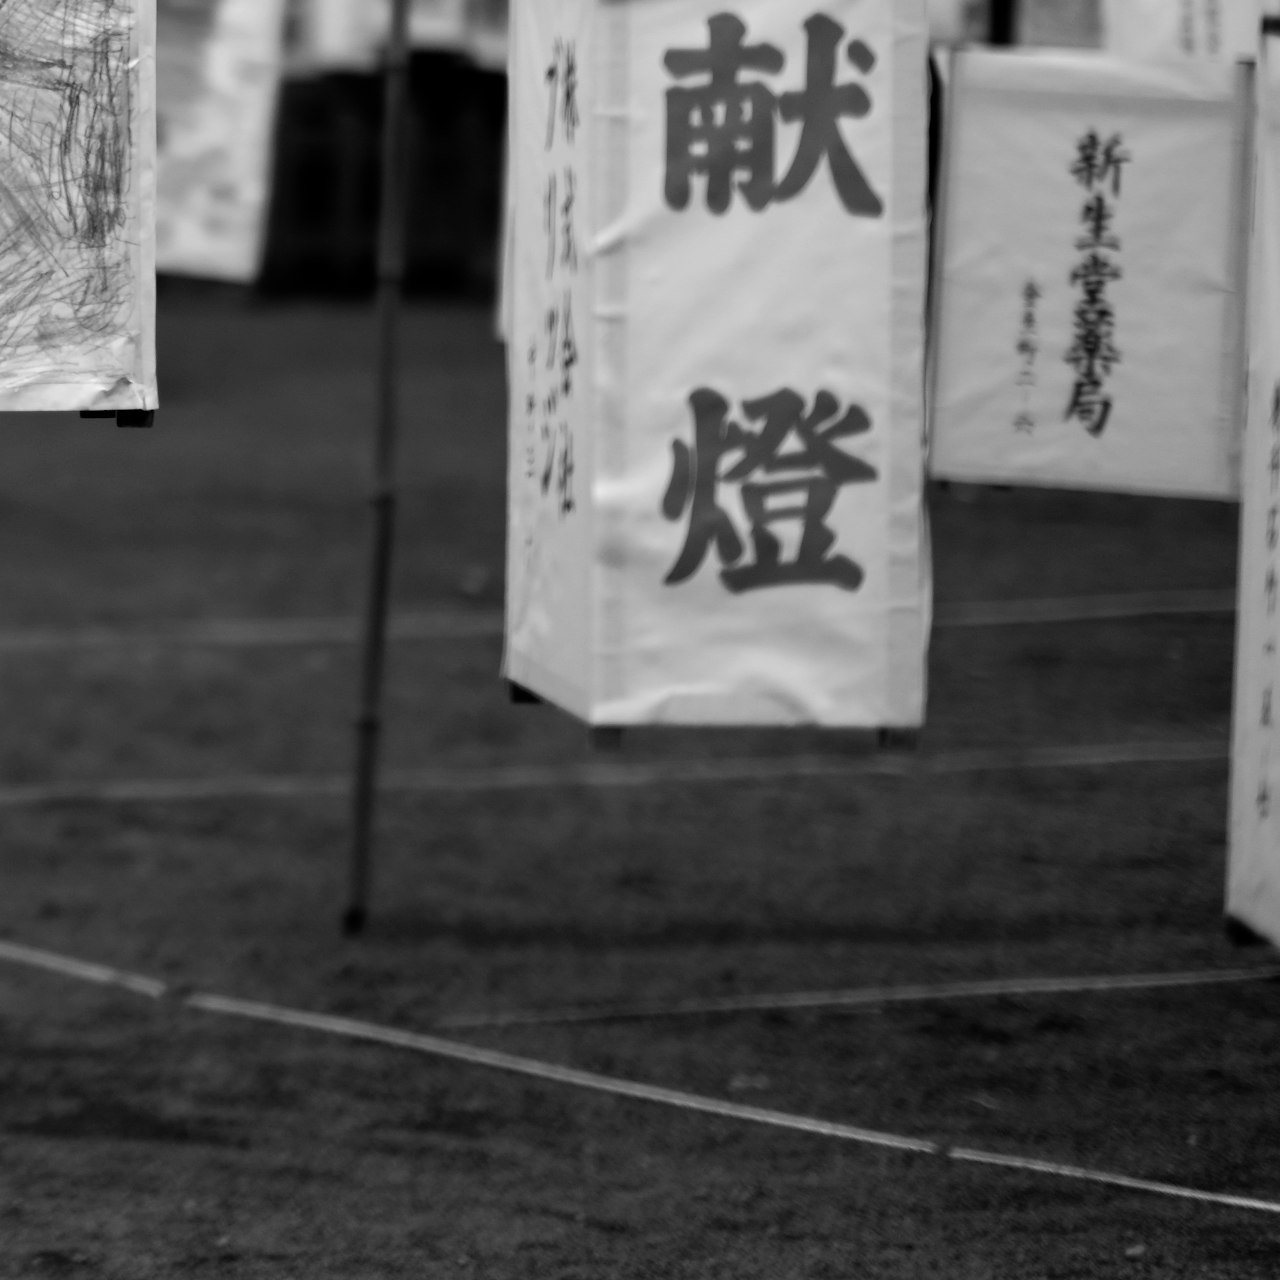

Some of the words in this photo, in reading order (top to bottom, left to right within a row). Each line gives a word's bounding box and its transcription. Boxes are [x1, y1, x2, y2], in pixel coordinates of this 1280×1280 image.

[661, 10, 886, 594] 献燈
[1062, 125, 1135, 440] 新生堂薬局
